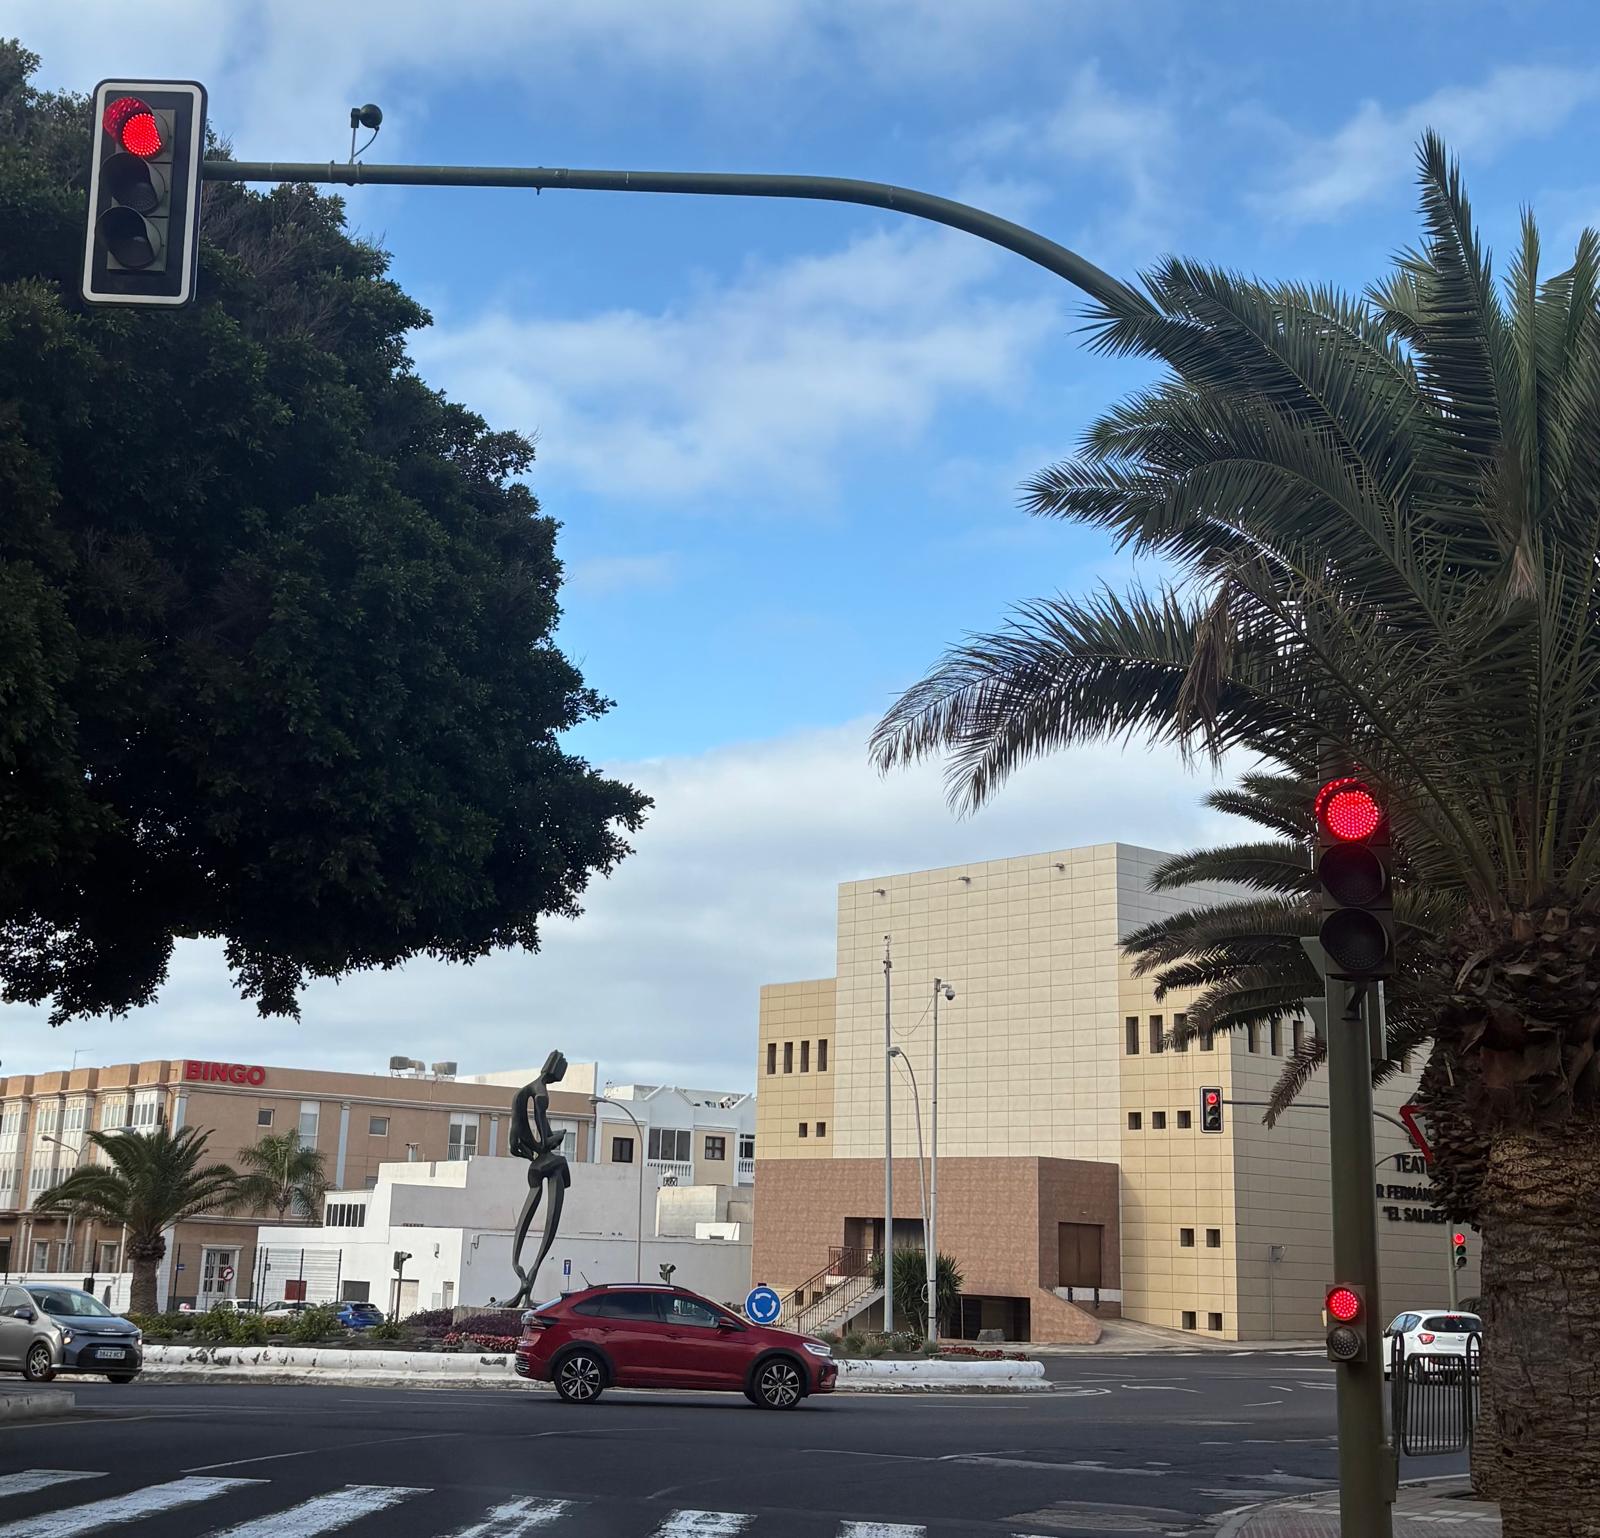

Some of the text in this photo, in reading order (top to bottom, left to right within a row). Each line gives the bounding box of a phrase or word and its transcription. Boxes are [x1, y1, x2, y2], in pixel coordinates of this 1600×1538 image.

[185, 1060, 266, 1086] BINGO
[1395, 1154, 1425, 1174] TEAT
[1376, 1182, 1432, 1201] R FERNÁN
